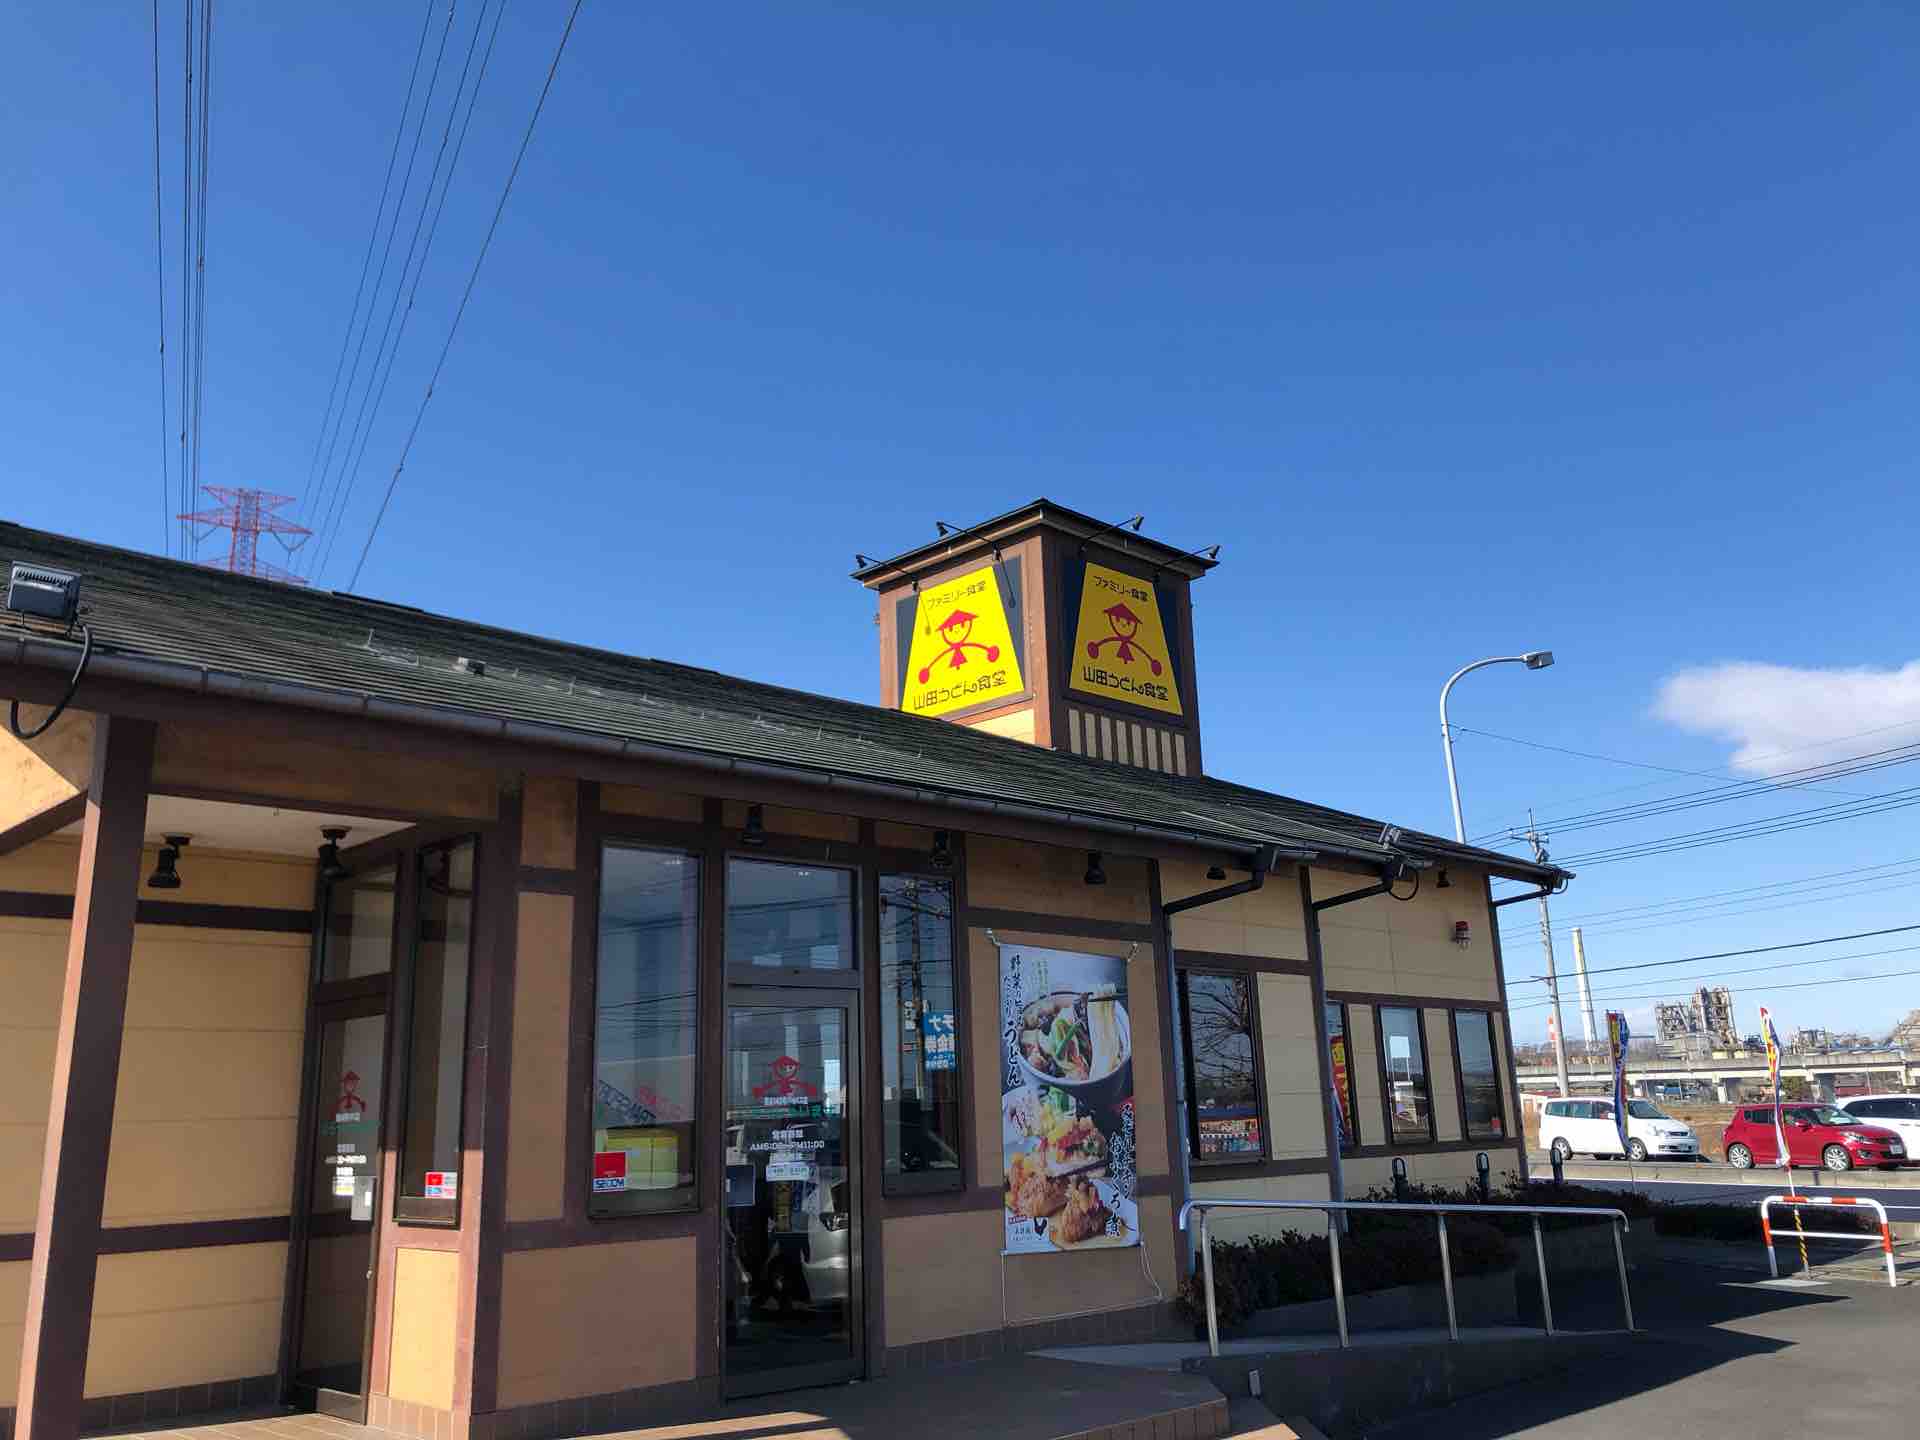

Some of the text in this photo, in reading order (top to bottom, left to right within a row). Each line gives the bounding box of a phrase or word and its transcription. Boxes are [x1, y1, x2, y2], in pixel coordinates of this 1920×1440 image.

[927, 581, 987, 609] ファミリー食堂
[1093, 575, 1151, 602] ファミリー食堂
[913, 670, 1008, 711] 山田うどん食堂
[1083, 666, 1169, 701] 山田うどん食堂
[1004, 1020, 1021, 1087] うどん
